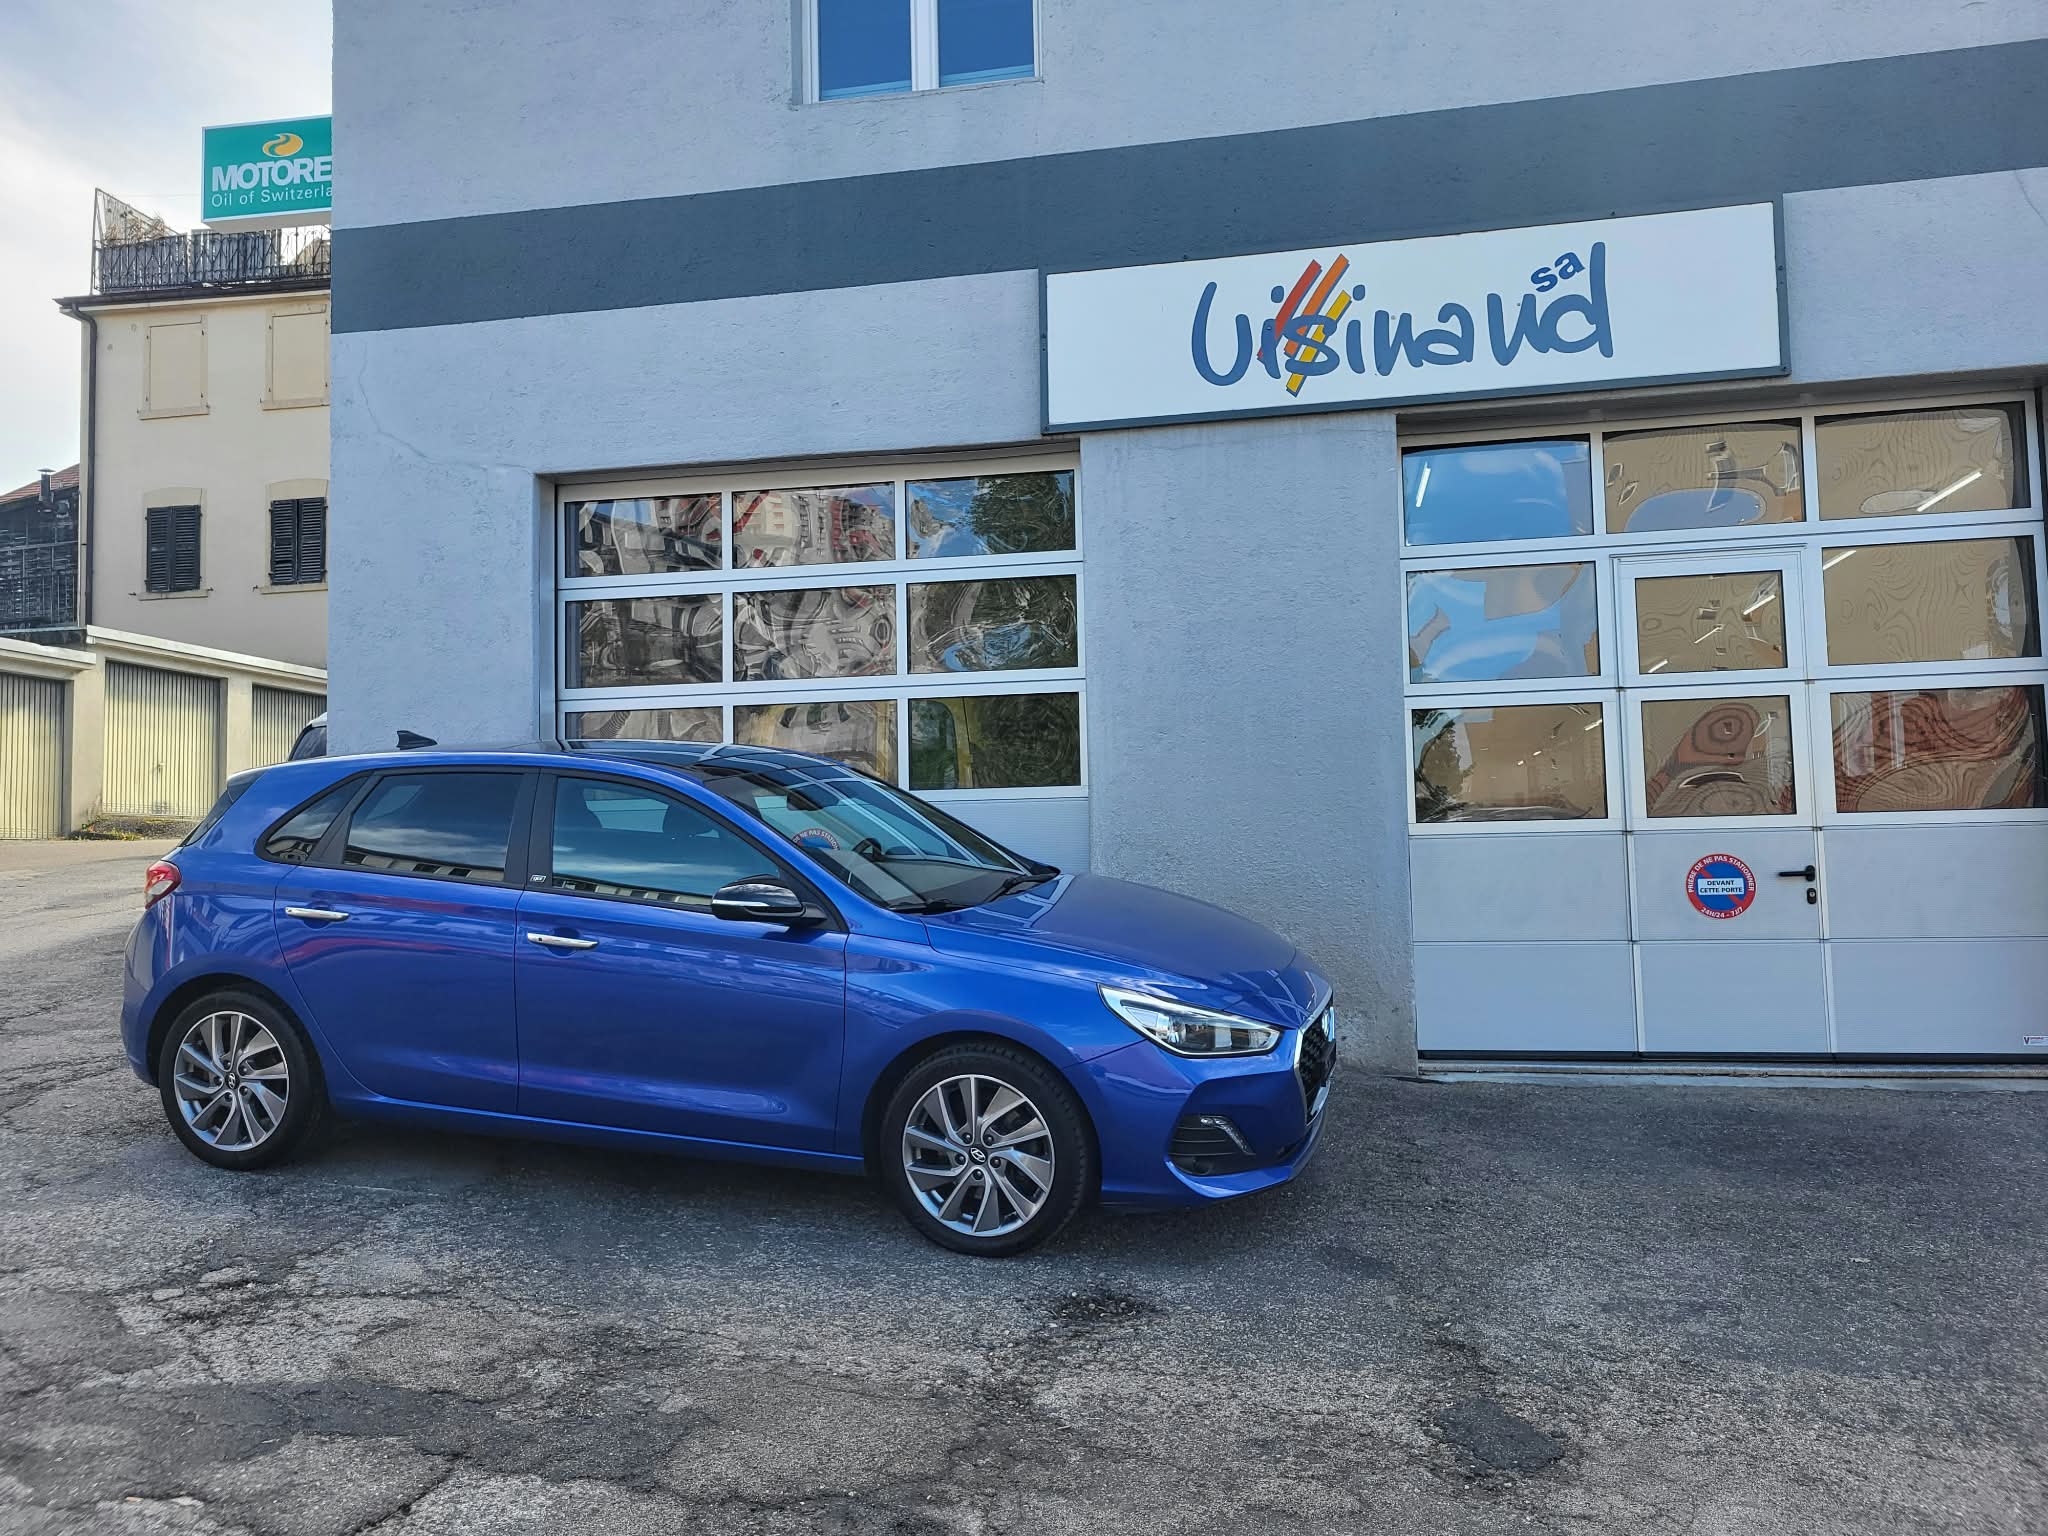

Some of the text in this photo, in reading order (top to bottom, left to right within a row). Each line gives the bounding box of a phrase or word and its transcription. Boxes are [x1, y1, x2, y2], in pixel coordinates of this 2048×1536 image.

[212, 155, 332, 191] MOTORE
[211, 193, 232, 207] Oil
[239, 190, 255, 205] of
[1729, 857, 1755, 891] STATIONNER
